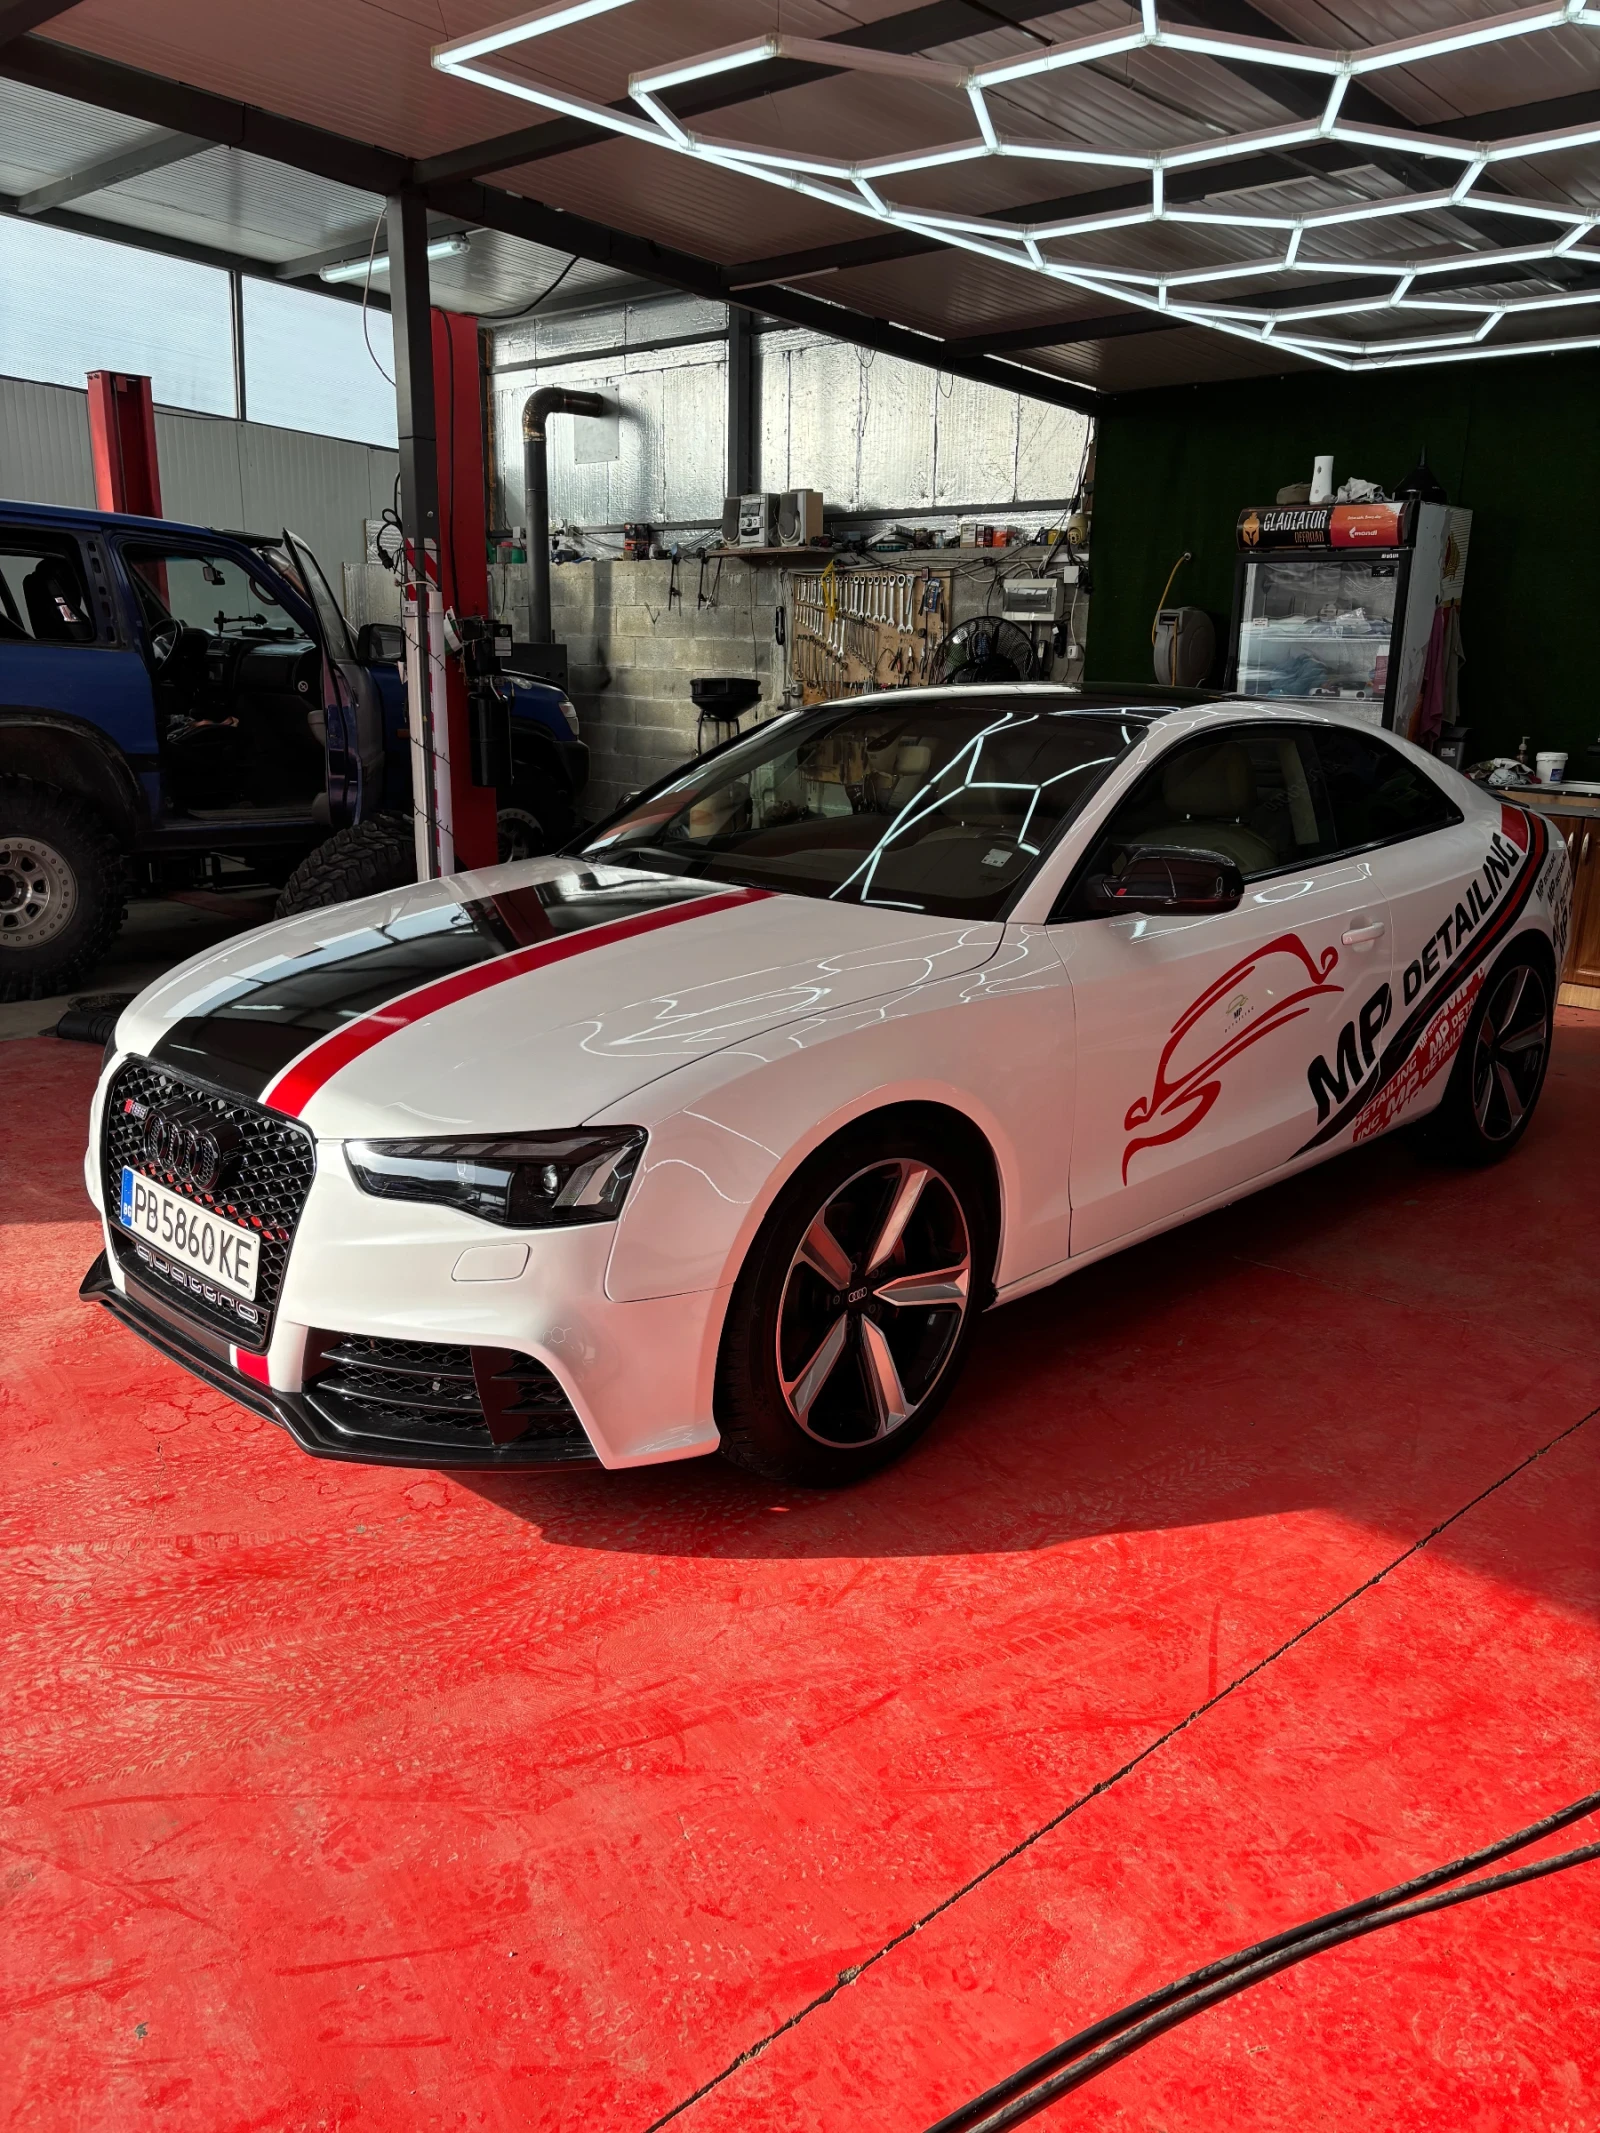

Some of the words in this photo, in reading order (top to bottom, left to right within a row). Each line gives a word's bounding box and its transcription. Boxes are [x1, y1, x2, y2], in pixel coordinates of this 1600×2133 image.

[1263, 509, 1328, 531] GLADIATOR
[1294, 530, 1325, 543] OFFROAD
[1307, 982, 1392, 1126] MP
[1402, 832, 1521, 1007] DETAILING
[1355, 1055, 1417, 1129] DETAILING
[1429, 1019, 1450, 1060] MP
[1386, 1070, 1420, 1119] MP
[122, 1203, 132, 1217] BG
[136, 1243, 259, 1325] quattro
